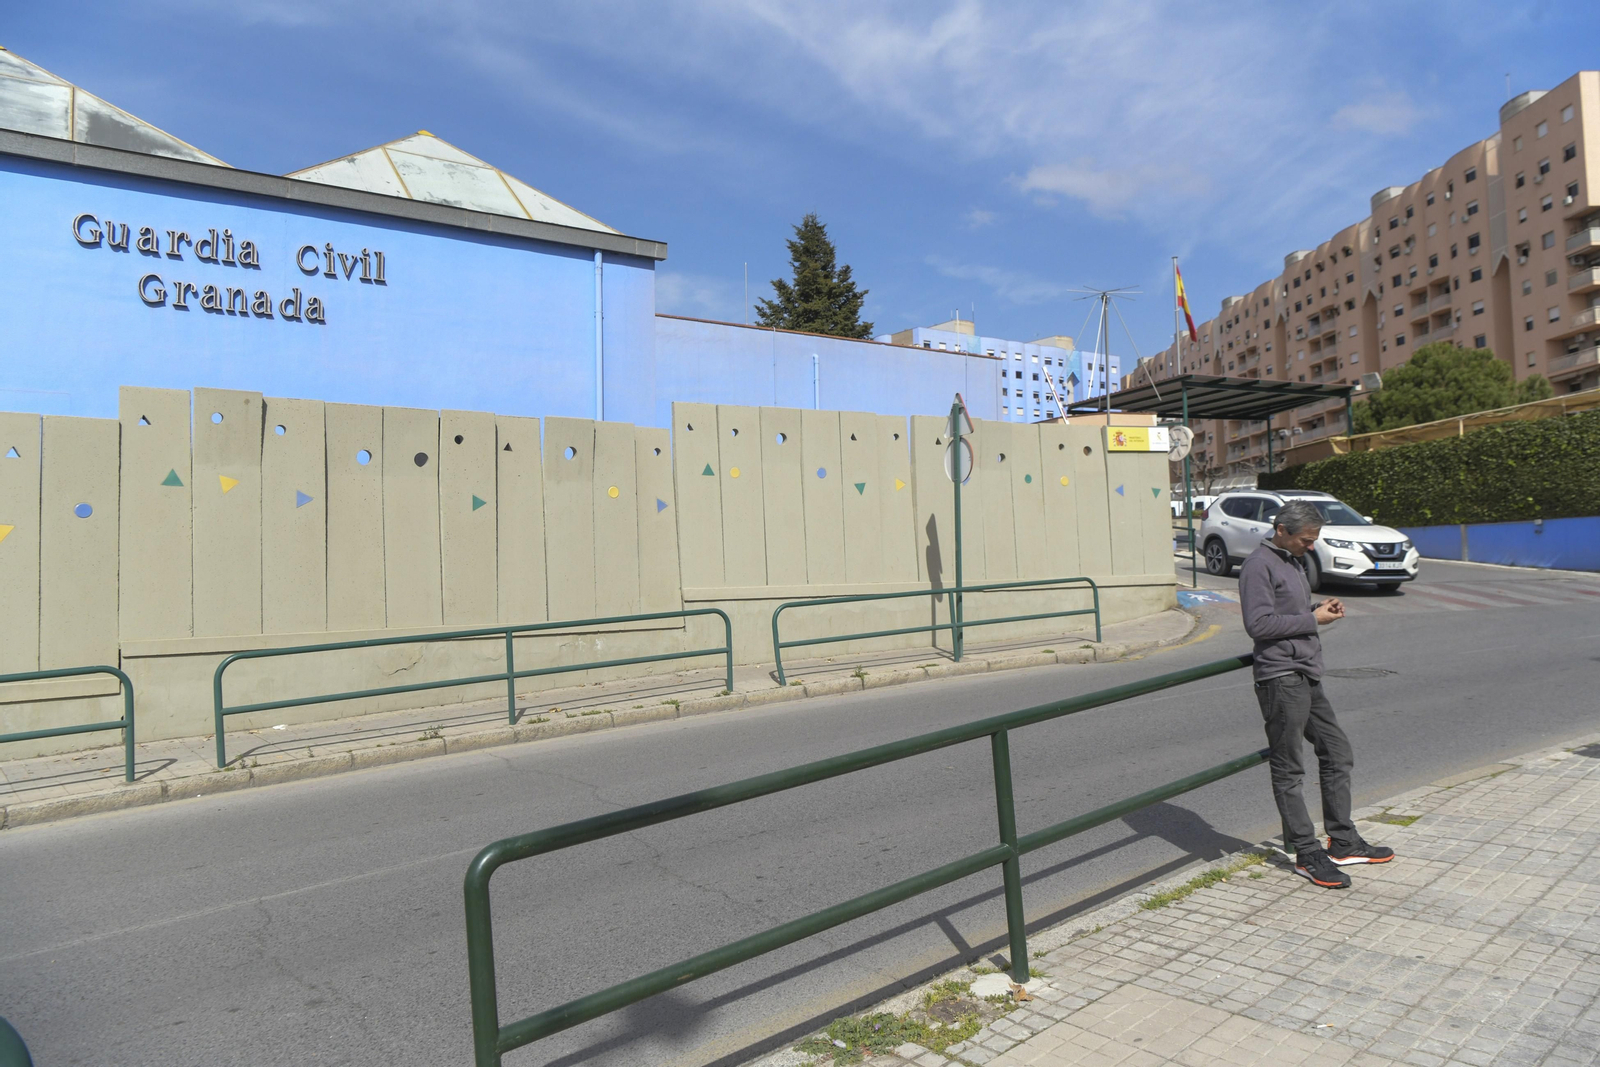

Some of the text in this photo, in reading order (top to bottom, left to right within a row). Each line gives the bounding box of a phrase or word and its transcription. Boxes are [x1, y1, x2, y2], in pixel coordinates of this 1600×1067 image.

[71, 213, 387, 283] Guardia Civil
[137, 273, 326, 322] Granada
